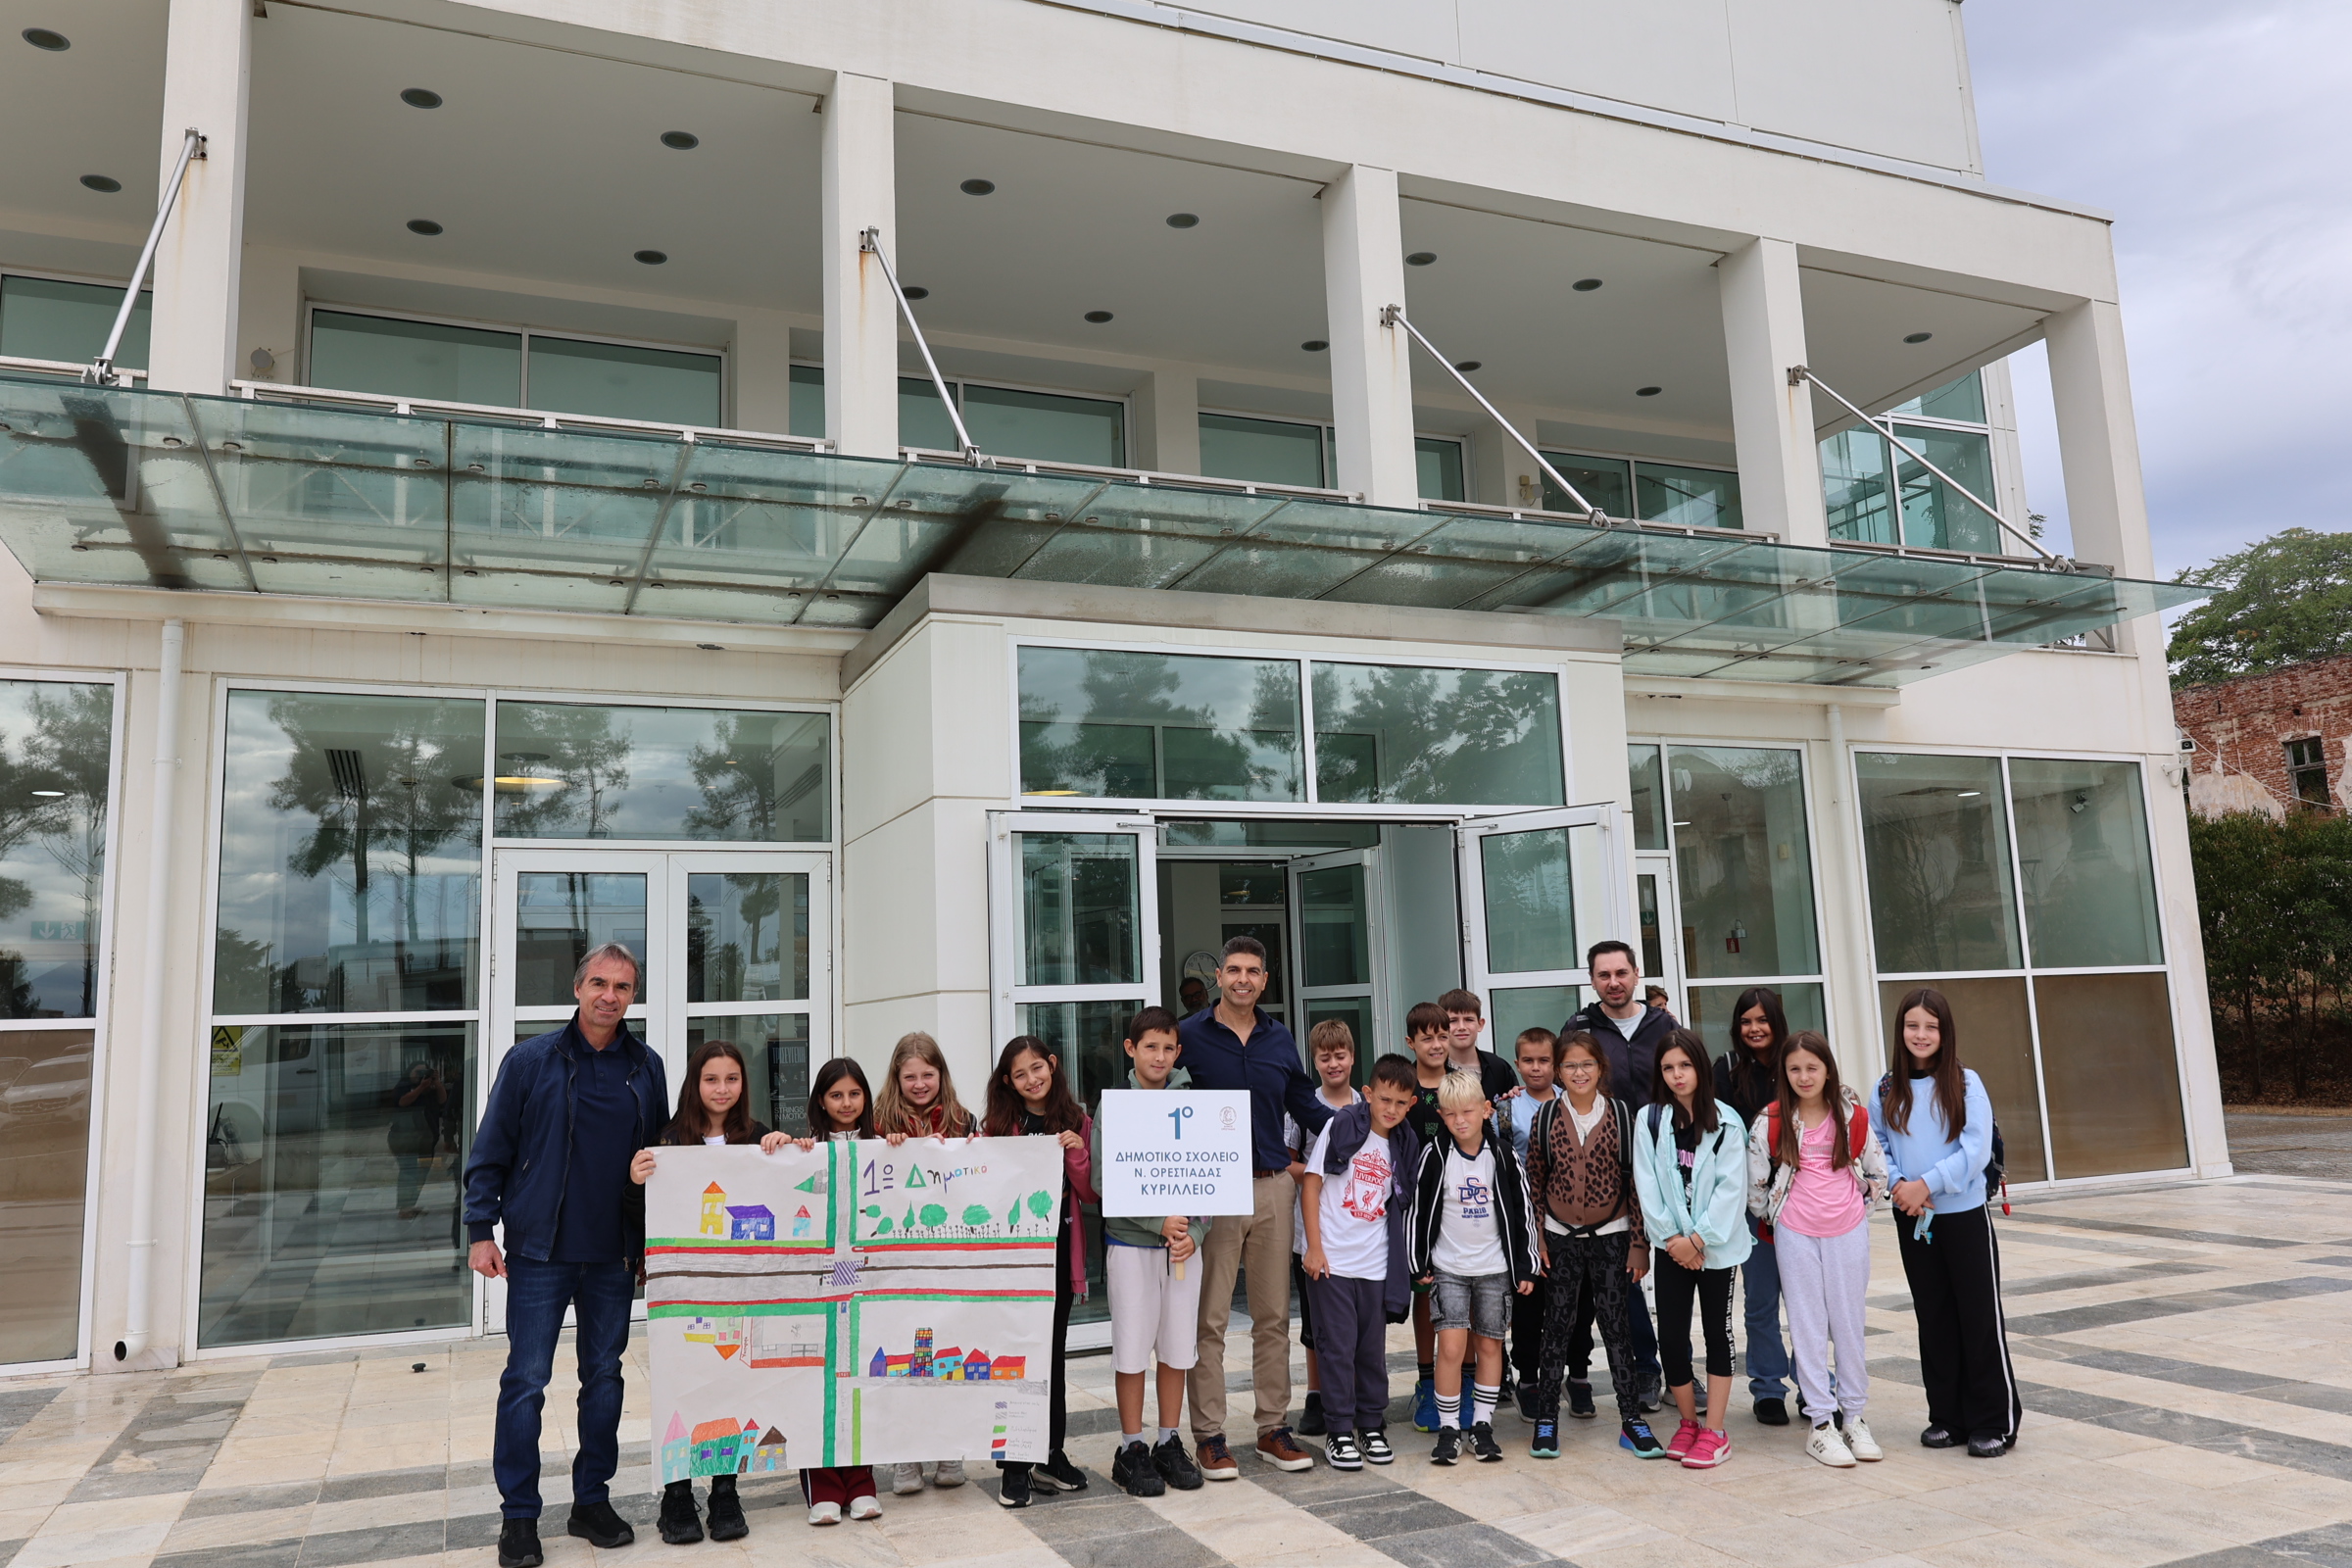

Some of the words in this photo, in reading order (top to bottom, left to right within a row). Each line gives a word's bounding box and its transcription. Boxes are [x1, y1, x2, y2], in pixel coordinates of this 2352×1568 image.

[1115, 1152, 1182, 1162] ΔΗΜΟΤΙΚΟ
[1185, 1152, 1239, 1162] ΣΧΟΛΕΙΟ
[1150, 1167, 1222, 1178] ΟΡΕΣΤΙΑΔΑΣ
[1355, 1171, 1384, 1185] LIVERPOO
[1141, 1183, 1216, 1196] ΚΥΡΙΛΛΕΙΟ
